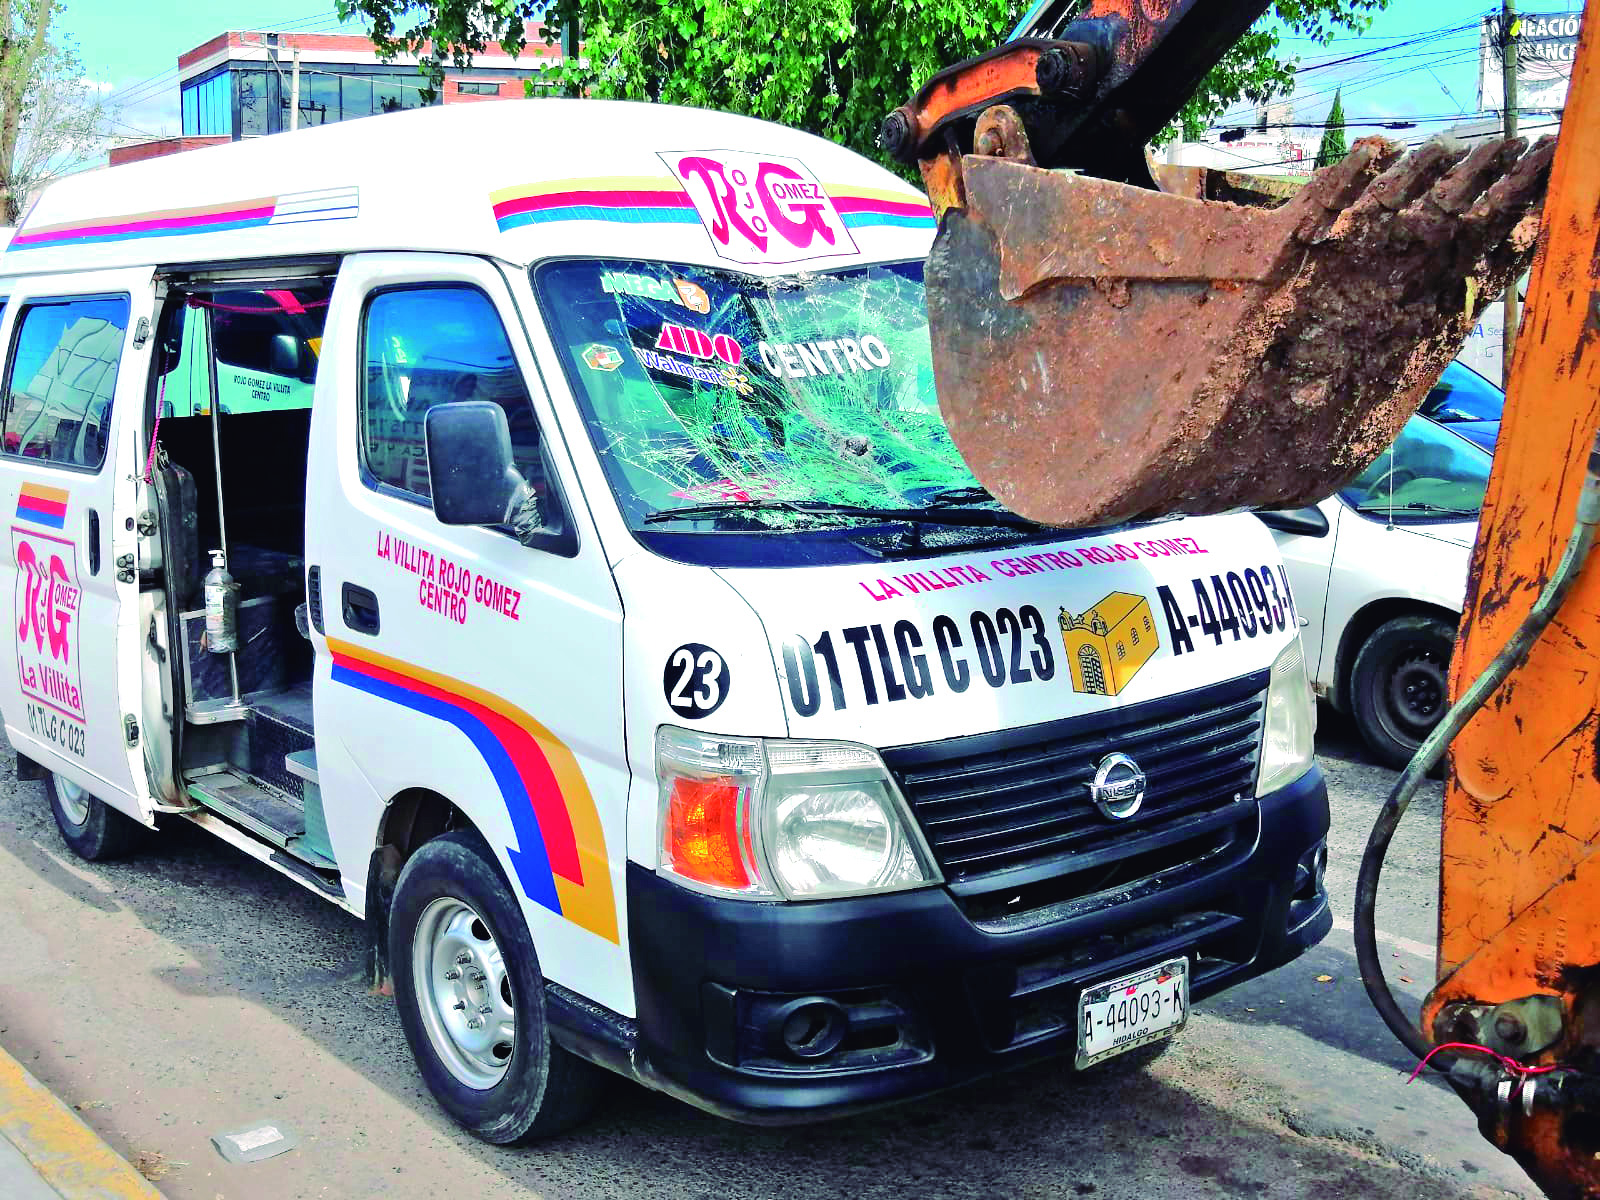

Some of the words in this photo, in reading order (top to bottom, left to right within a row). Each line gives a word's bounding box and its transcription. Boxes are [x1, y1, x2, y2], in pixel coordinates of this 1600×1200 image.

[599, 271, 685, 306] MEGA
[632, 345, 728, 387] Walmart
[655, 322, 743, 366] ADO
[758, 334, 891, 379] CENTRO
[234, 375, 247, 385] ROJO
[247, 378, 265, 389] GOMEZ
[266, 381, 272, 390] LA
[273, 383, 290, 395] VILLITA
[252, 389, 270, 401] CENTRO
[377, 530, 390, 561] LA
[394, 537, 435, 581] VILLITA
[438, 558, 471, 597] ROJO
[474, 574, 521, 621] GOMEZ
[859, 582, 904, 602] LA
[892, 564, 993, 595] VILLITA
[990, 550, 1083, 578] CENTRO
[1075, 543, 1140, 568] ROJO
[1136, 537, 1210, 558] GOMEZ
[419, 578, 468, 625] CENTRO
[20, 655, 37, 691] La
[39, 663, 81, 711] Villita
[670, 648, 722, 710] 23
[782, 633, 847, 718] 01
[842, 619, 935, 706] TLG
[932, 614, 970, 693] C
[969, 604, 1055, 688] 023
[37, 706, 57, 743] TLG
[59, 718, 66, 748] C
[68, 722, 85, 758] 023
[1085, 980, 1183, 1042] A-44093-K
[1112, 1027, 1149, 1046] HIDALGO
